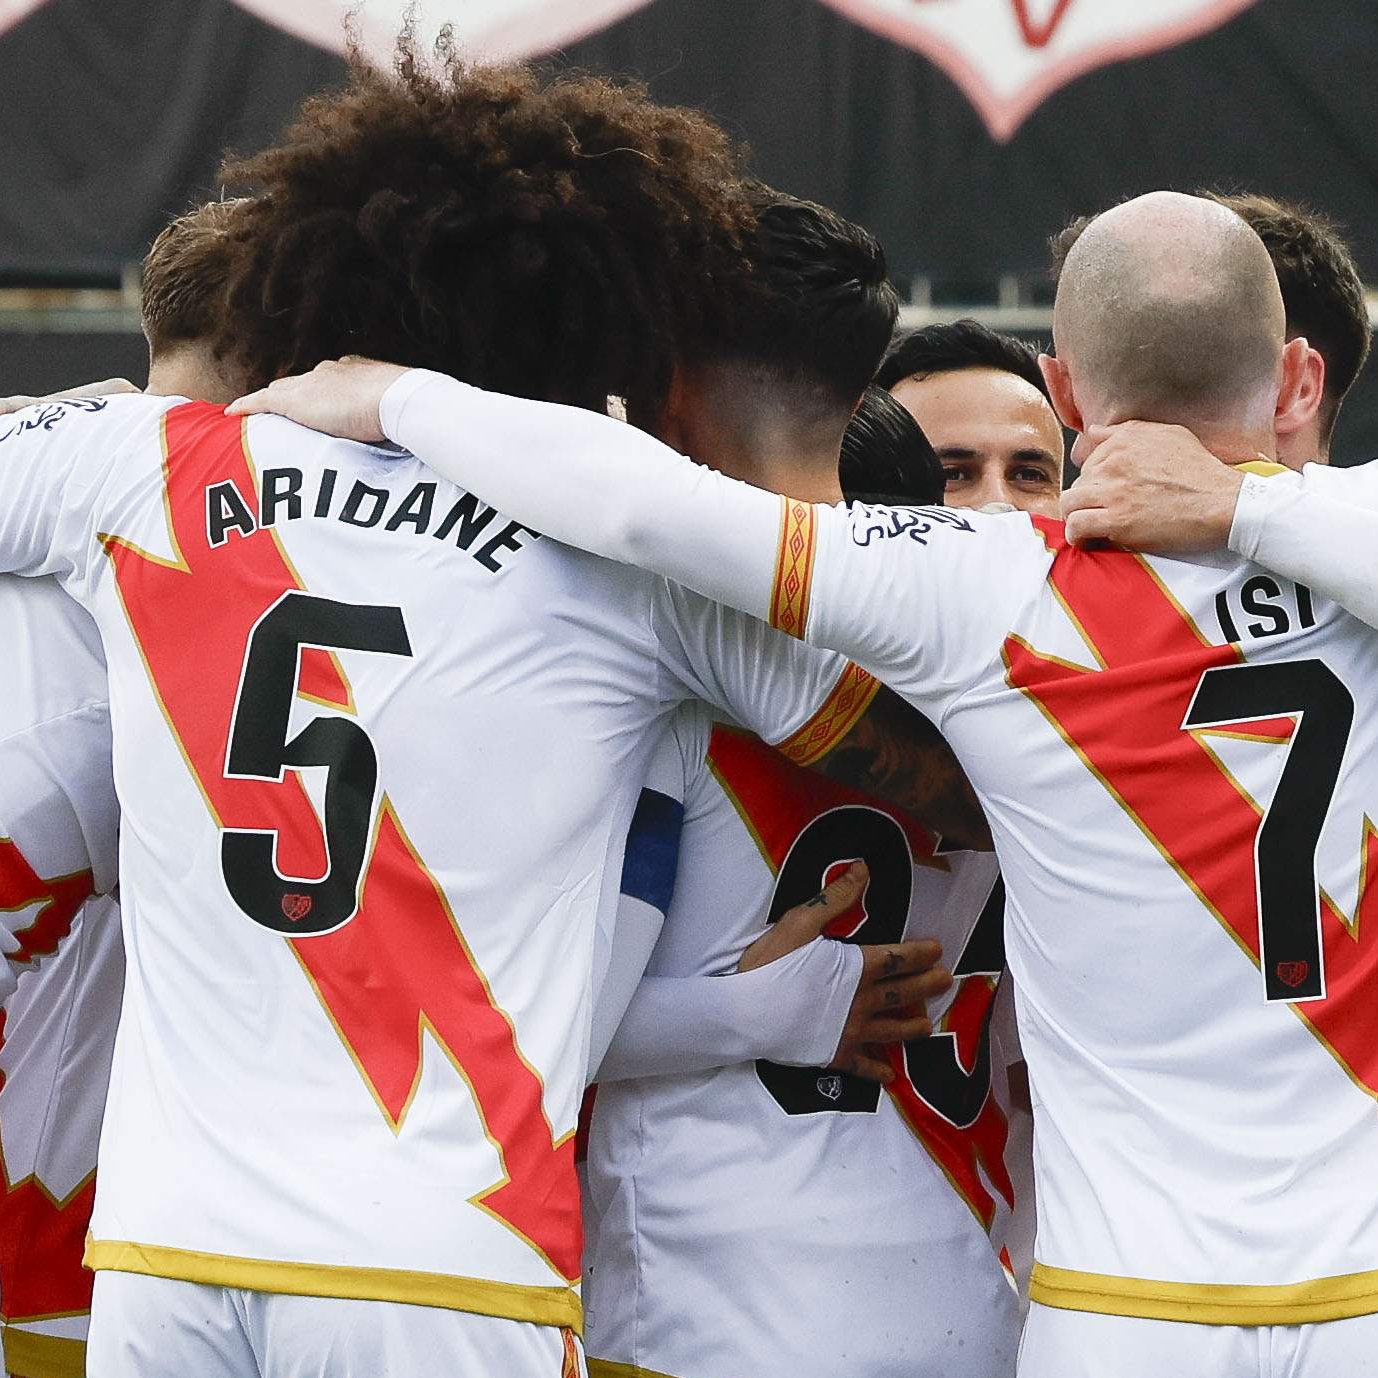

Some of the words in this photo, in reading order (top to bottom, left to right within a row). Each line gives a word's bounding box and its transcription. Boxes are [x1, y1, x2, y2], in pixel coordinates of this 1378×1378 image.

[206, 467, 541, 574] ARIDANE
[1215, 574, 1317, 644] ISI
[221, 590, 412, 937] 5
[1183, 657, 1355, 1003] 7
